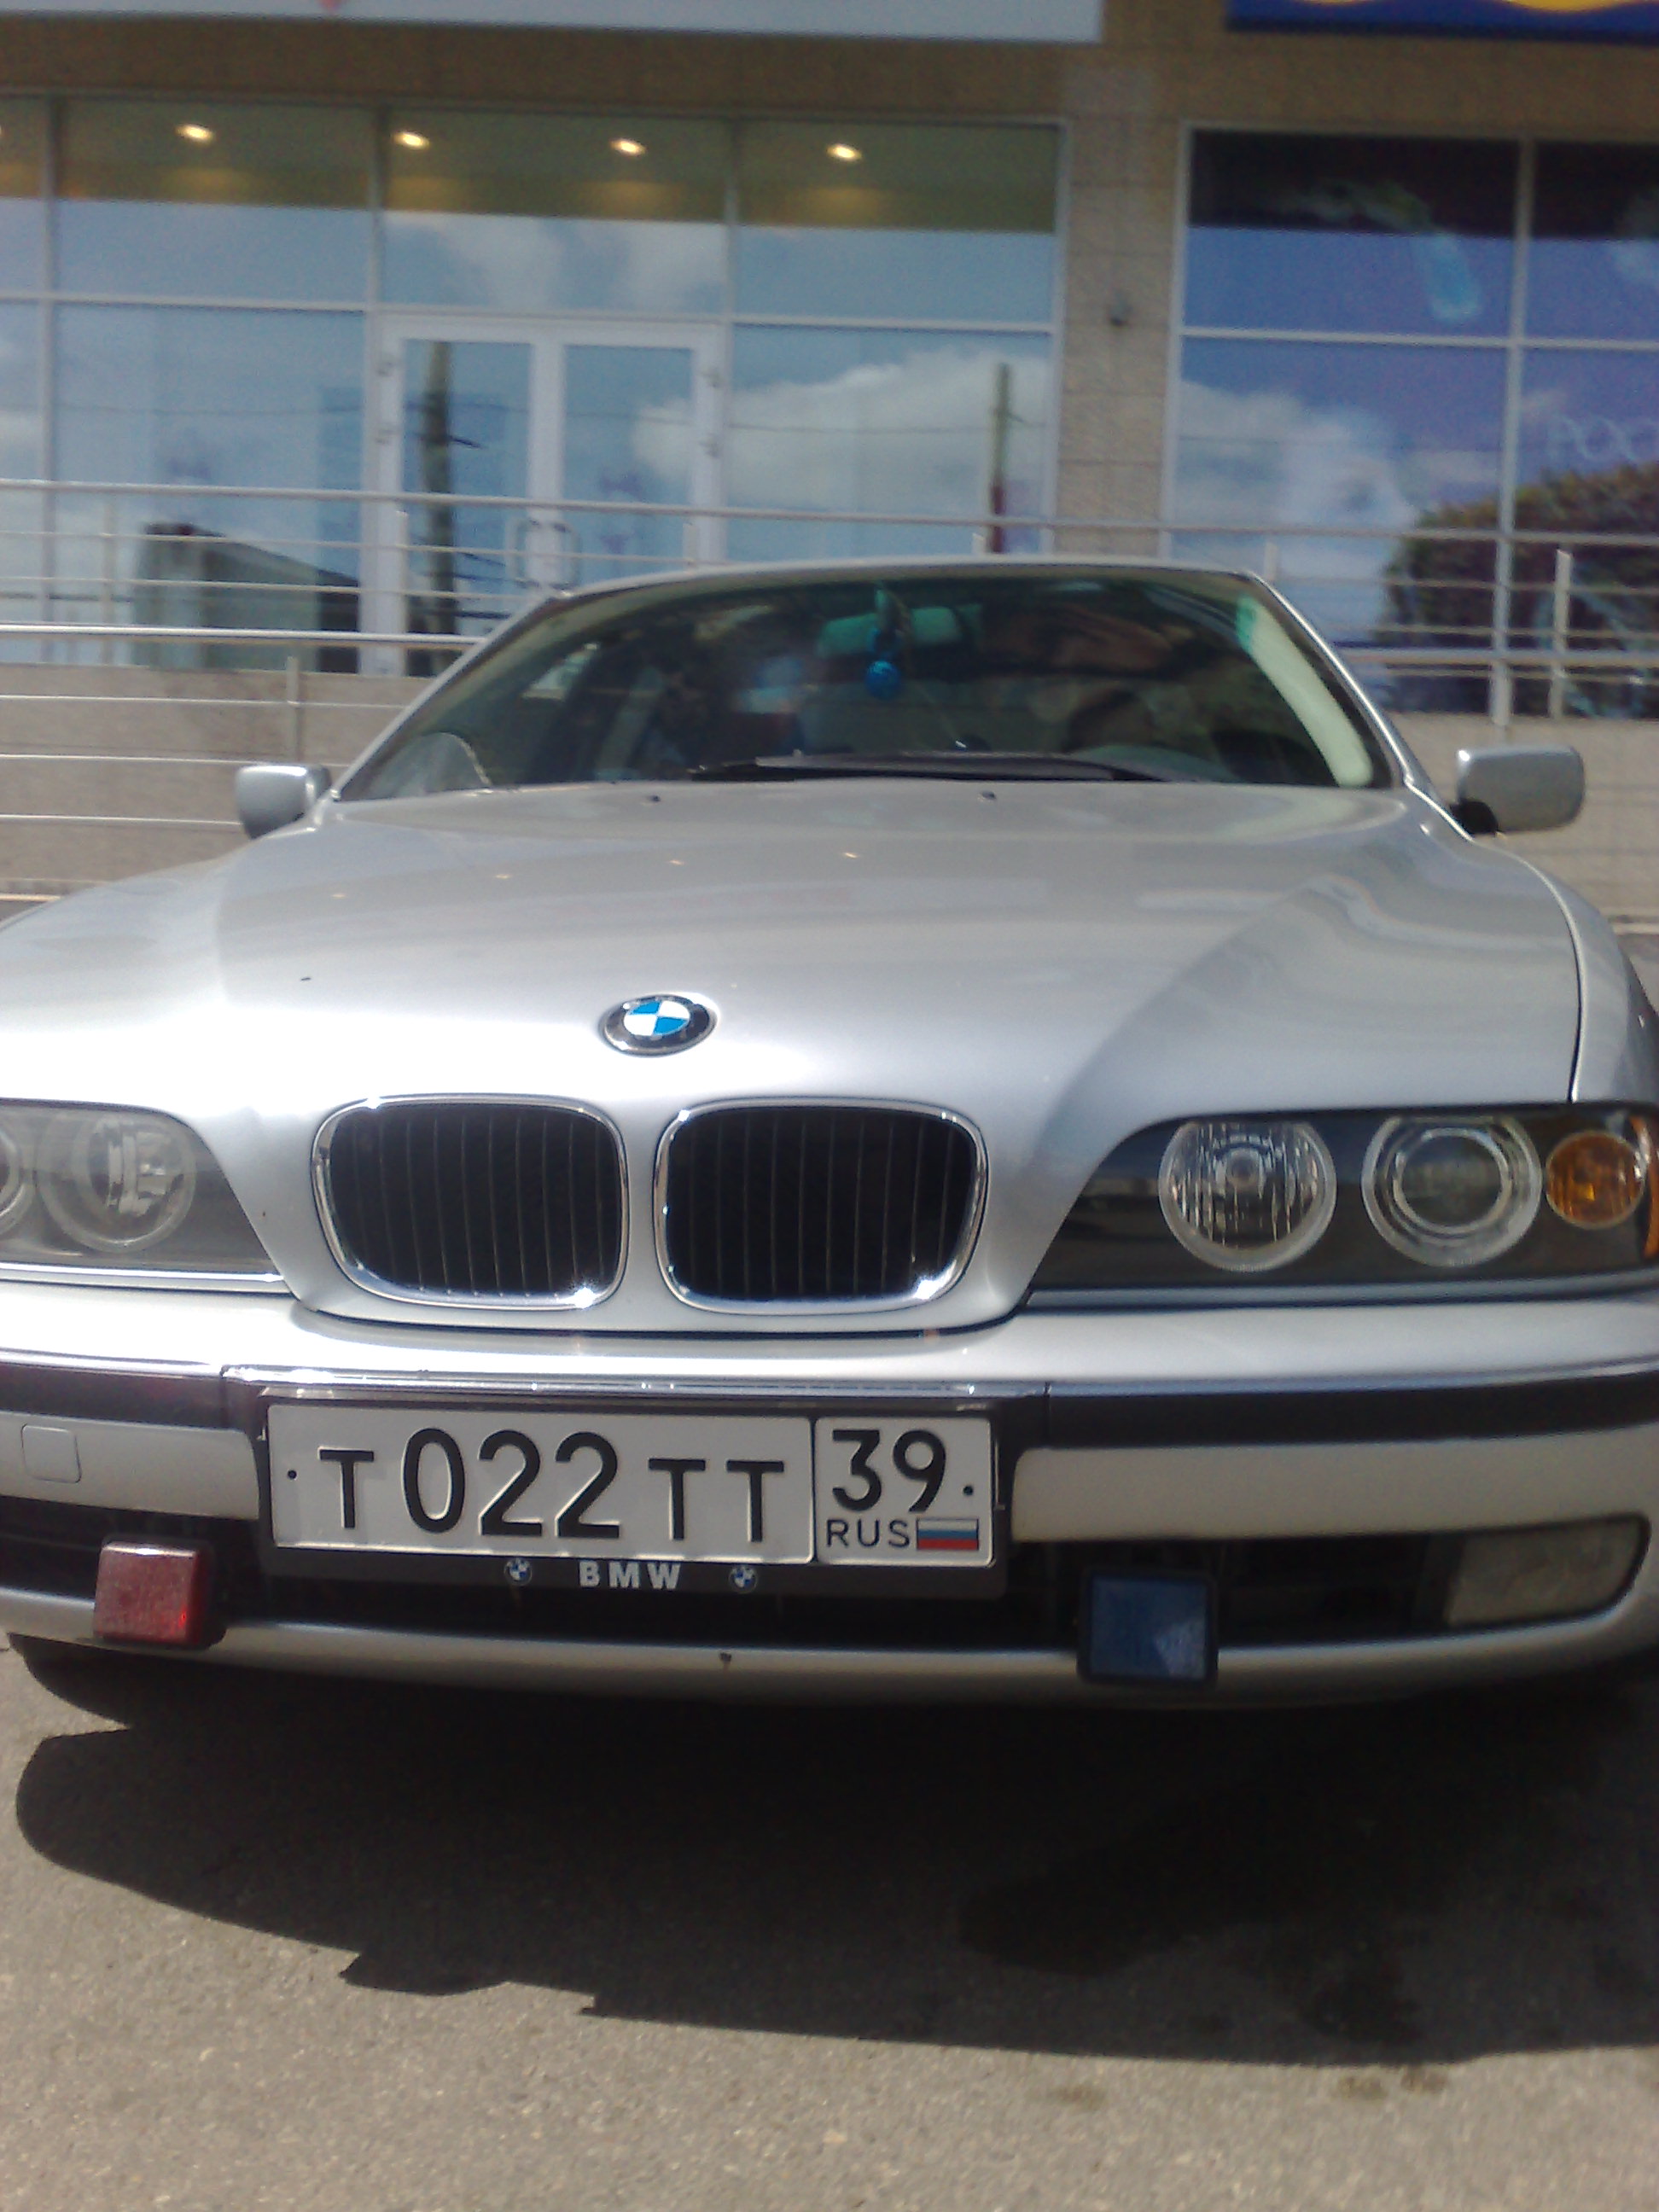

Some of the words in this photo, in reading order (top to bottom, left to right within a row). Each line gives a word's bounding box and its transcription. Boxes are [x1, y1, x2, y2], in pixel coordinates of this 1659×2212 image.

[831, 1429, 947, 1513] 39
[825, 1518, 911, 1548] RUS
[579, 1559, 682, 1591] BMW
